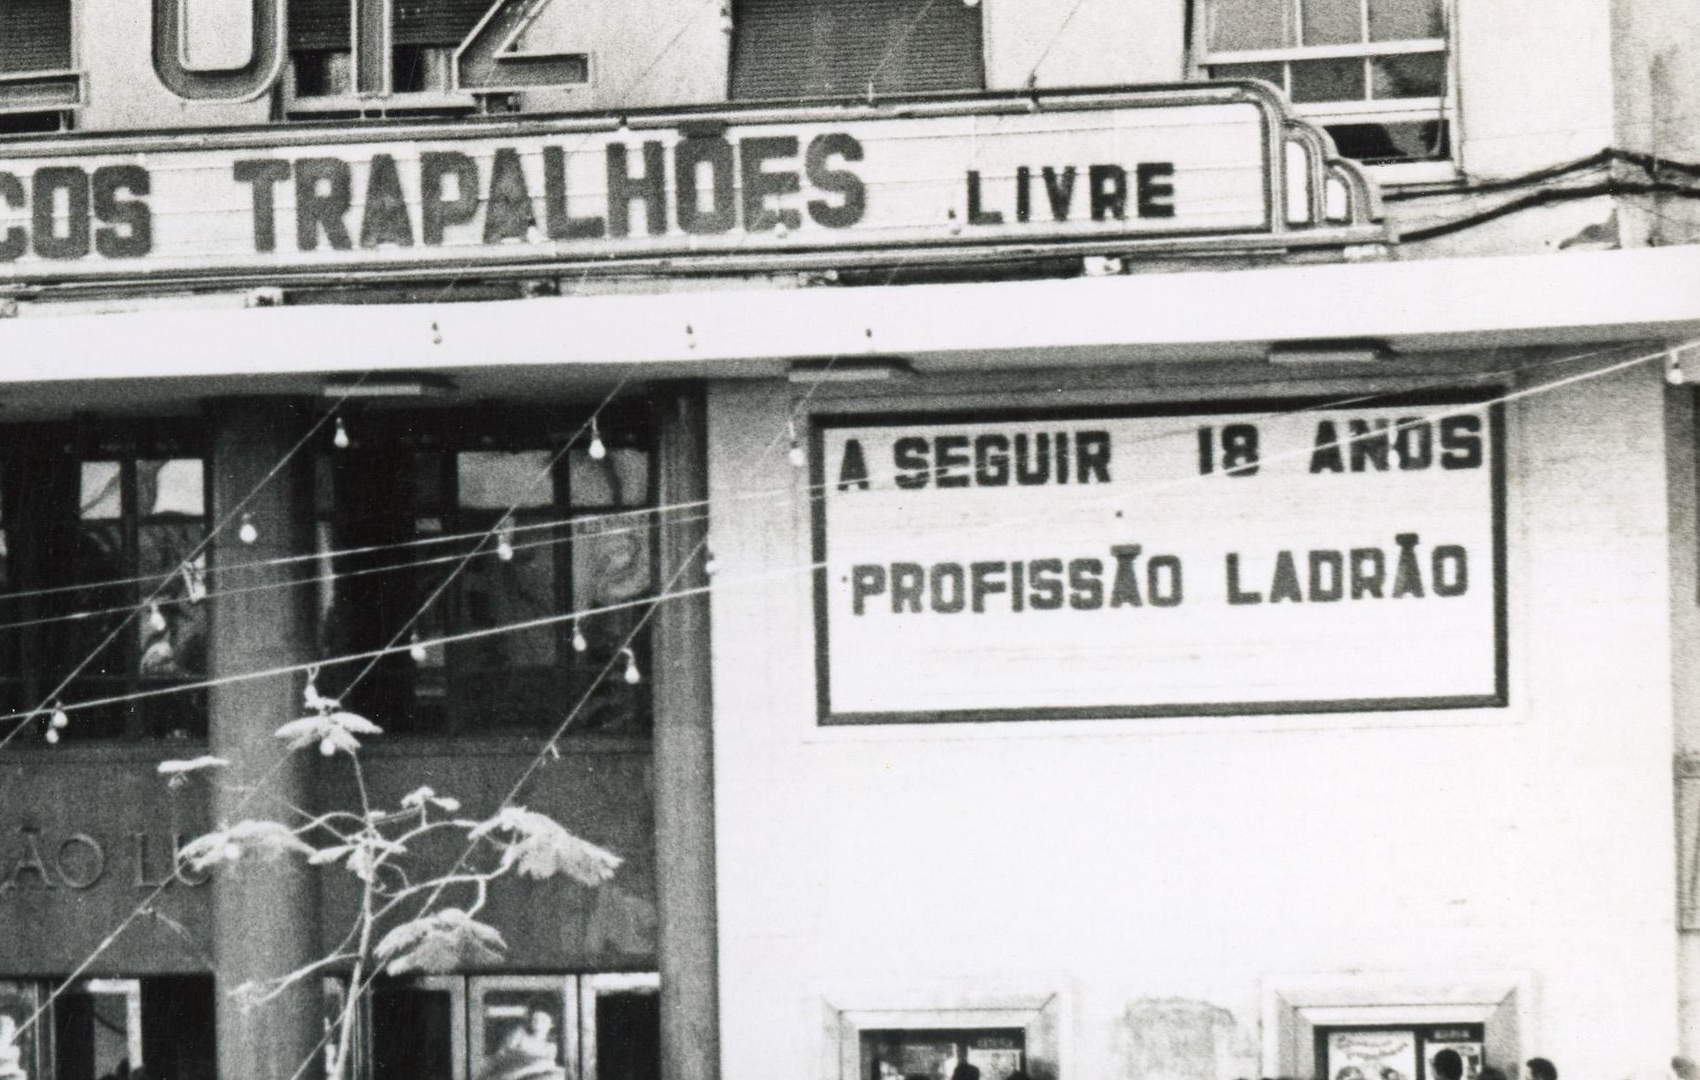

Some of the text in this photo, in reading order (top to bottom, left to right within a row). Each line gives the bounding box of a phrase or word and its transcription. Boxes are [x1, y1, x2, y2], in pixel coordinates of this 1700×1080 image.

[233, 121, 867, 254] TRAPALHÕES
[967, 161, 1176, 225] LIVRE
[838, 413, 1484, 491] A SEGUIR 18 ANOS
[851, 533, 1470, 615] PROFISSÃO LADRÃO
